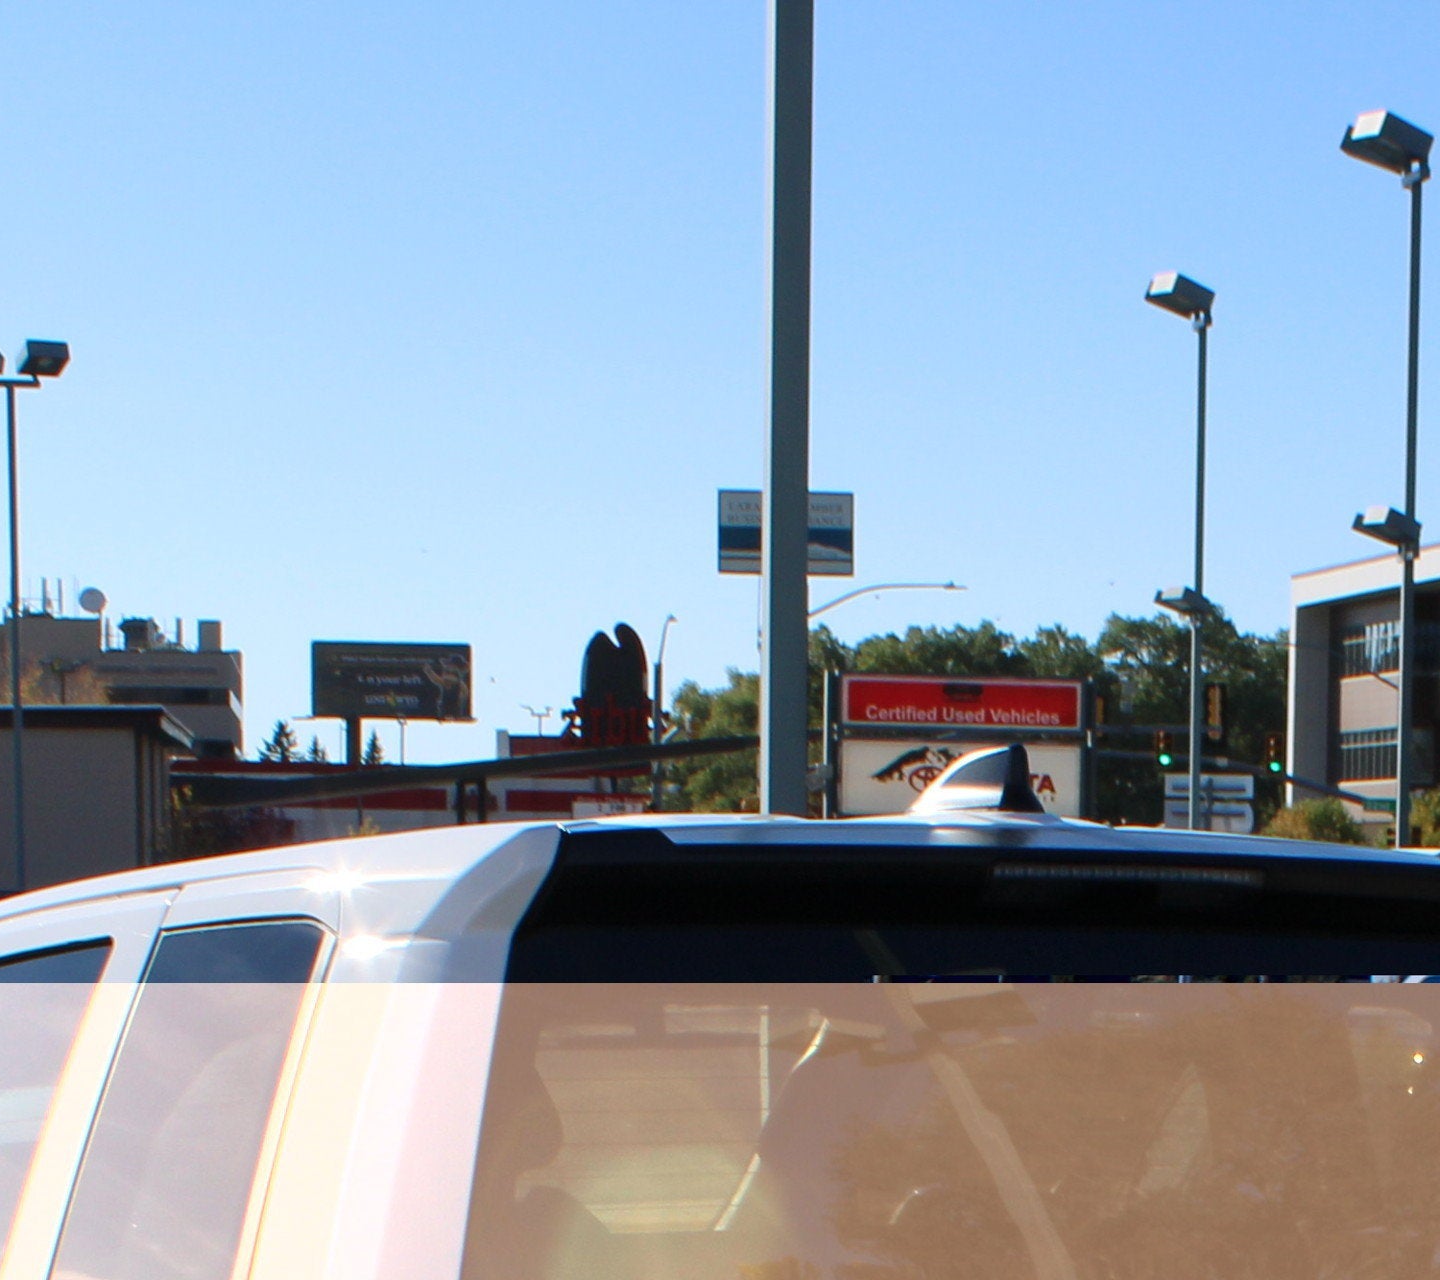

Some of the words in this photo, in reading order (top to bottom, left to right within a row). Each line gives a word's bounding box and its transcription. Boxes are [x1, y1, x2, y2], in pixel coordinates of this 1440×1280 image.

[866, 704, 938, 723] Certified
[942, 707, 985, 724] Used
[989, 708, 1060, 726] Vehicles
